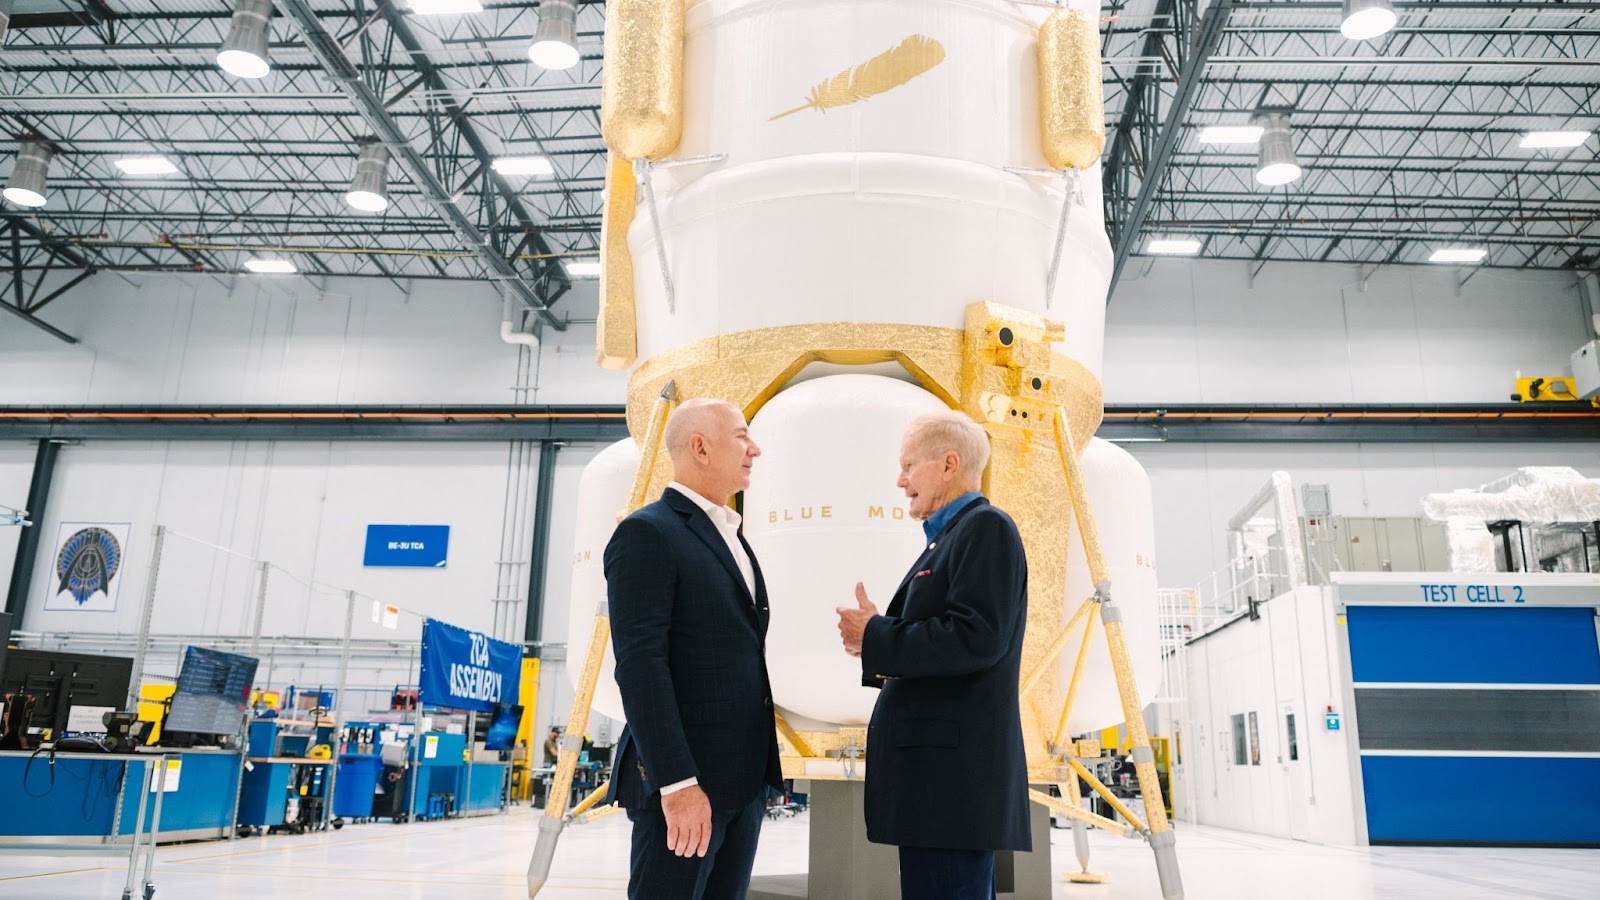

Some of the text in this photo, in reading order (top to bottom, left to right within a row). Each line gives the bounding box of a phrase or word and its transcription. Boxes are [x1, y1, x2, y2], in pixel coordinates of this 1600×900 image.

[768, 505, 922, 523] BLUE MO
[410, 541, 424, 550] TCA
[573, 549, 591, 565] ON
[1420, 584, 1525, 603] TEST CELL 2
[469, 633, 490, 668] TCA
[450, 662, 503, 704] ASSEMBLY
